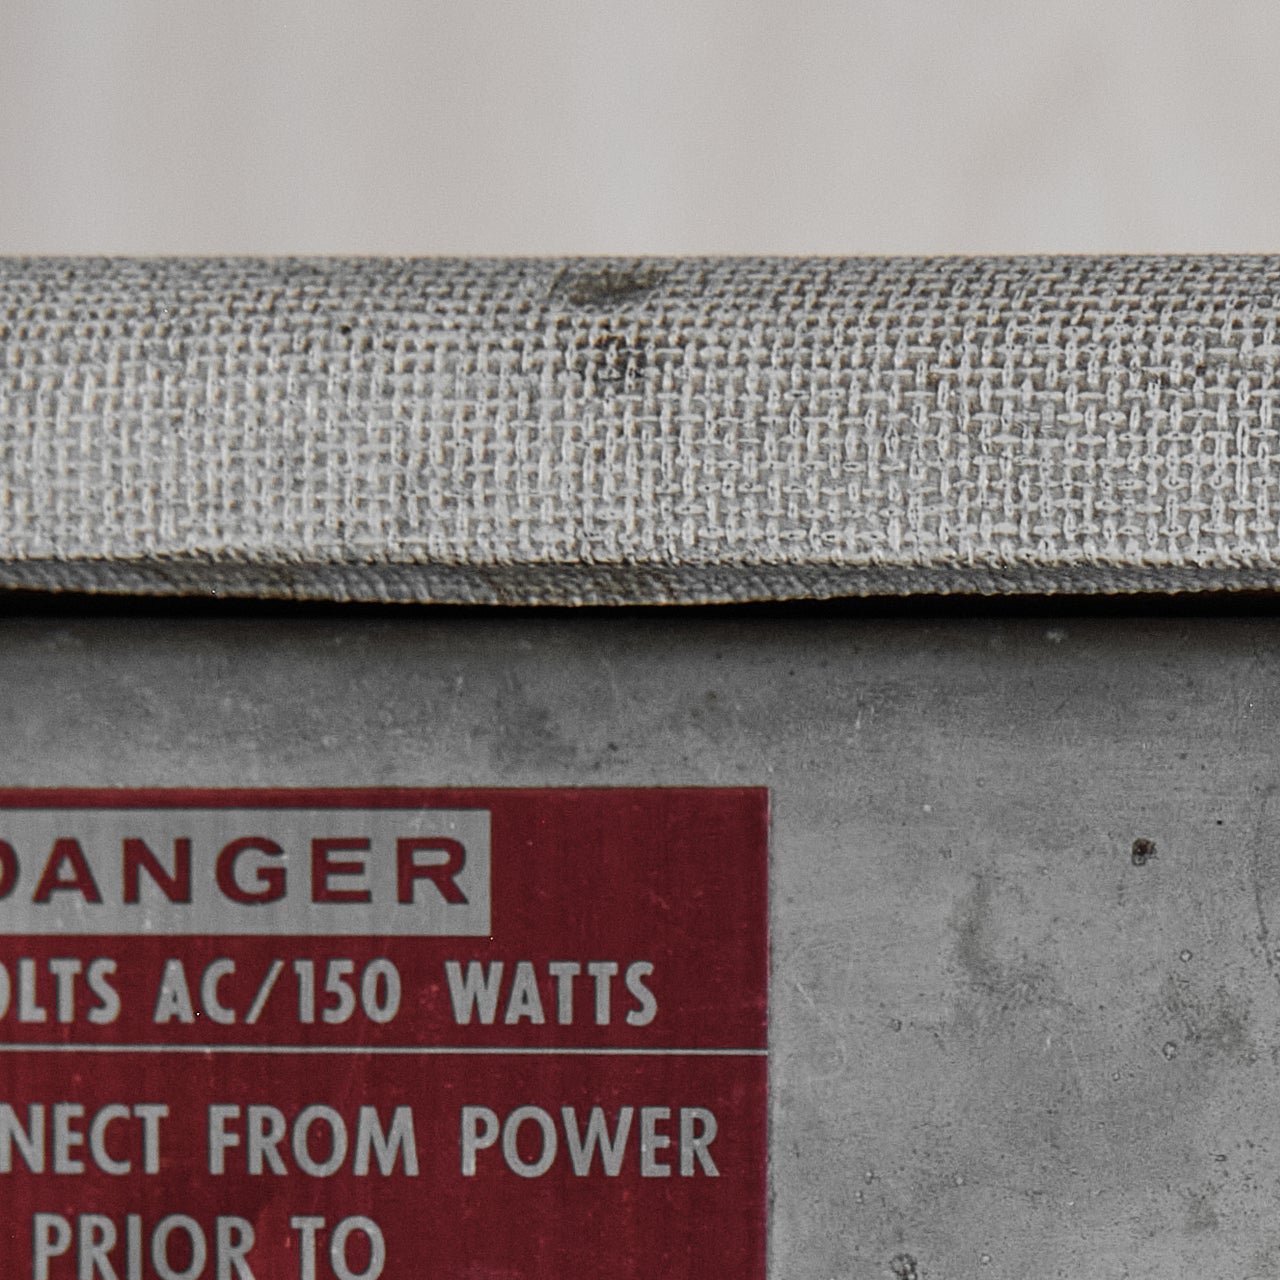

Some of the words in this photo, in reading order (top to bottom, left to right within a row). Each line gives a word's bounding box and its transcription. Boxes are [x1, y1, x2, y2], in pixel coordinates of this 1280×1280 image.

[0, 836, 470, 906] ANGER
[0, 957, 121, 1024] LTS
[153, 958, 401, 1024] AC/150
[444, 961, 658, 1026] WATTS
[207, 1104, 420, 1178] FROM
[460, 1106, 721, 1178] POWER
